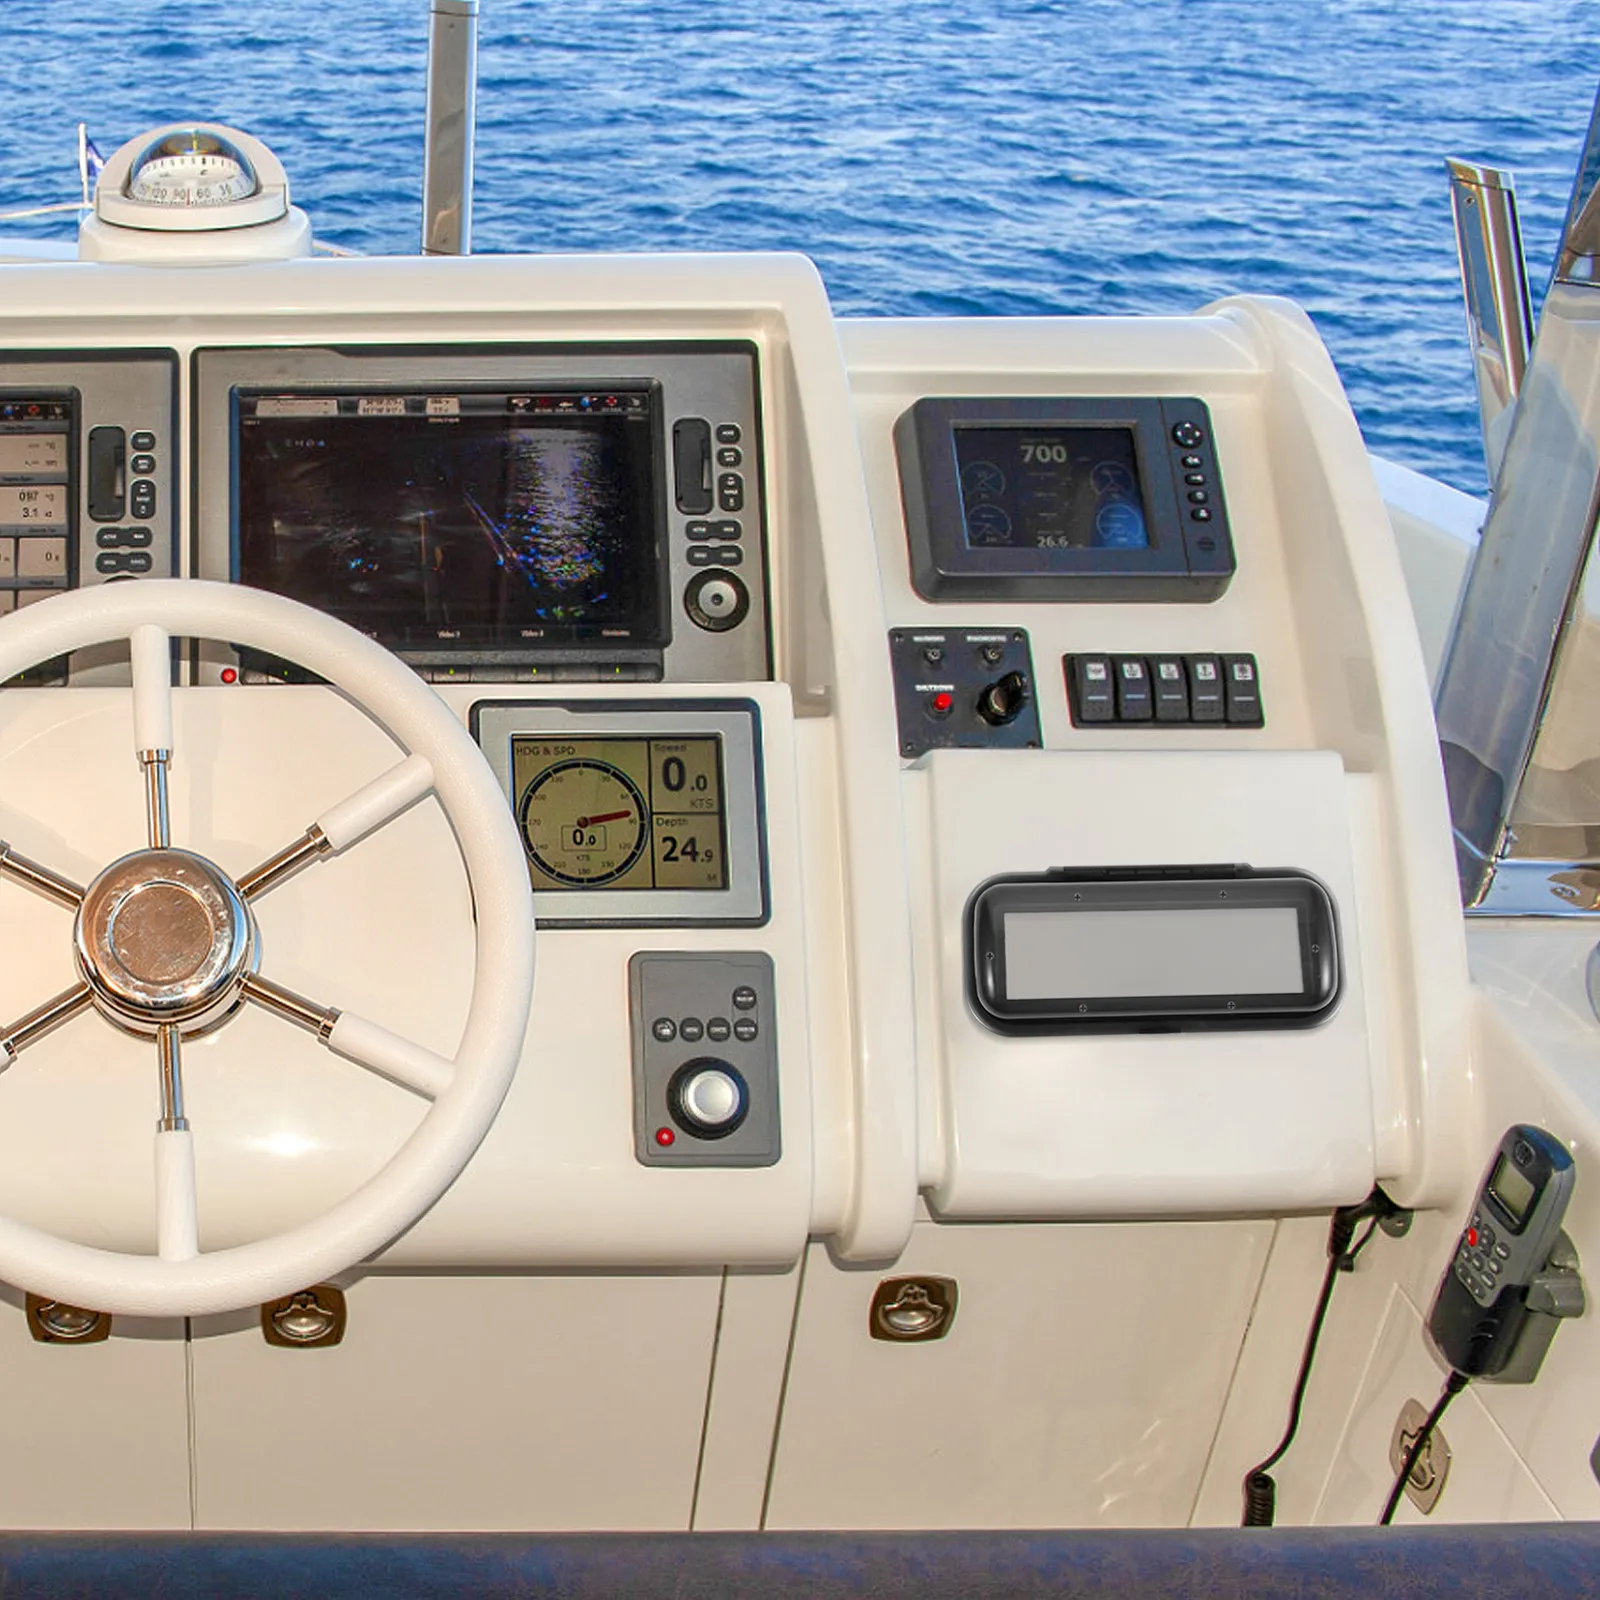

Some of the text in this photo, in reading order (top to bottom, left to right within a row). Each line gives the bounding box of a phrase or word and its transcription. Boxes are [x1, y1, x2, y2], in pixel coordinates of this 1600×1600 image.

[1020, 445, 1067, 464] 700
[516, 745, 540, 756] HDG
[553, 745, 576, 756] SPD
[689, 798, 714, 809] KTS
[656, 817, 689, 827] Depth
[572, 828, 597, 847] 0.0
[661, 835, 714, 863] 24.9
